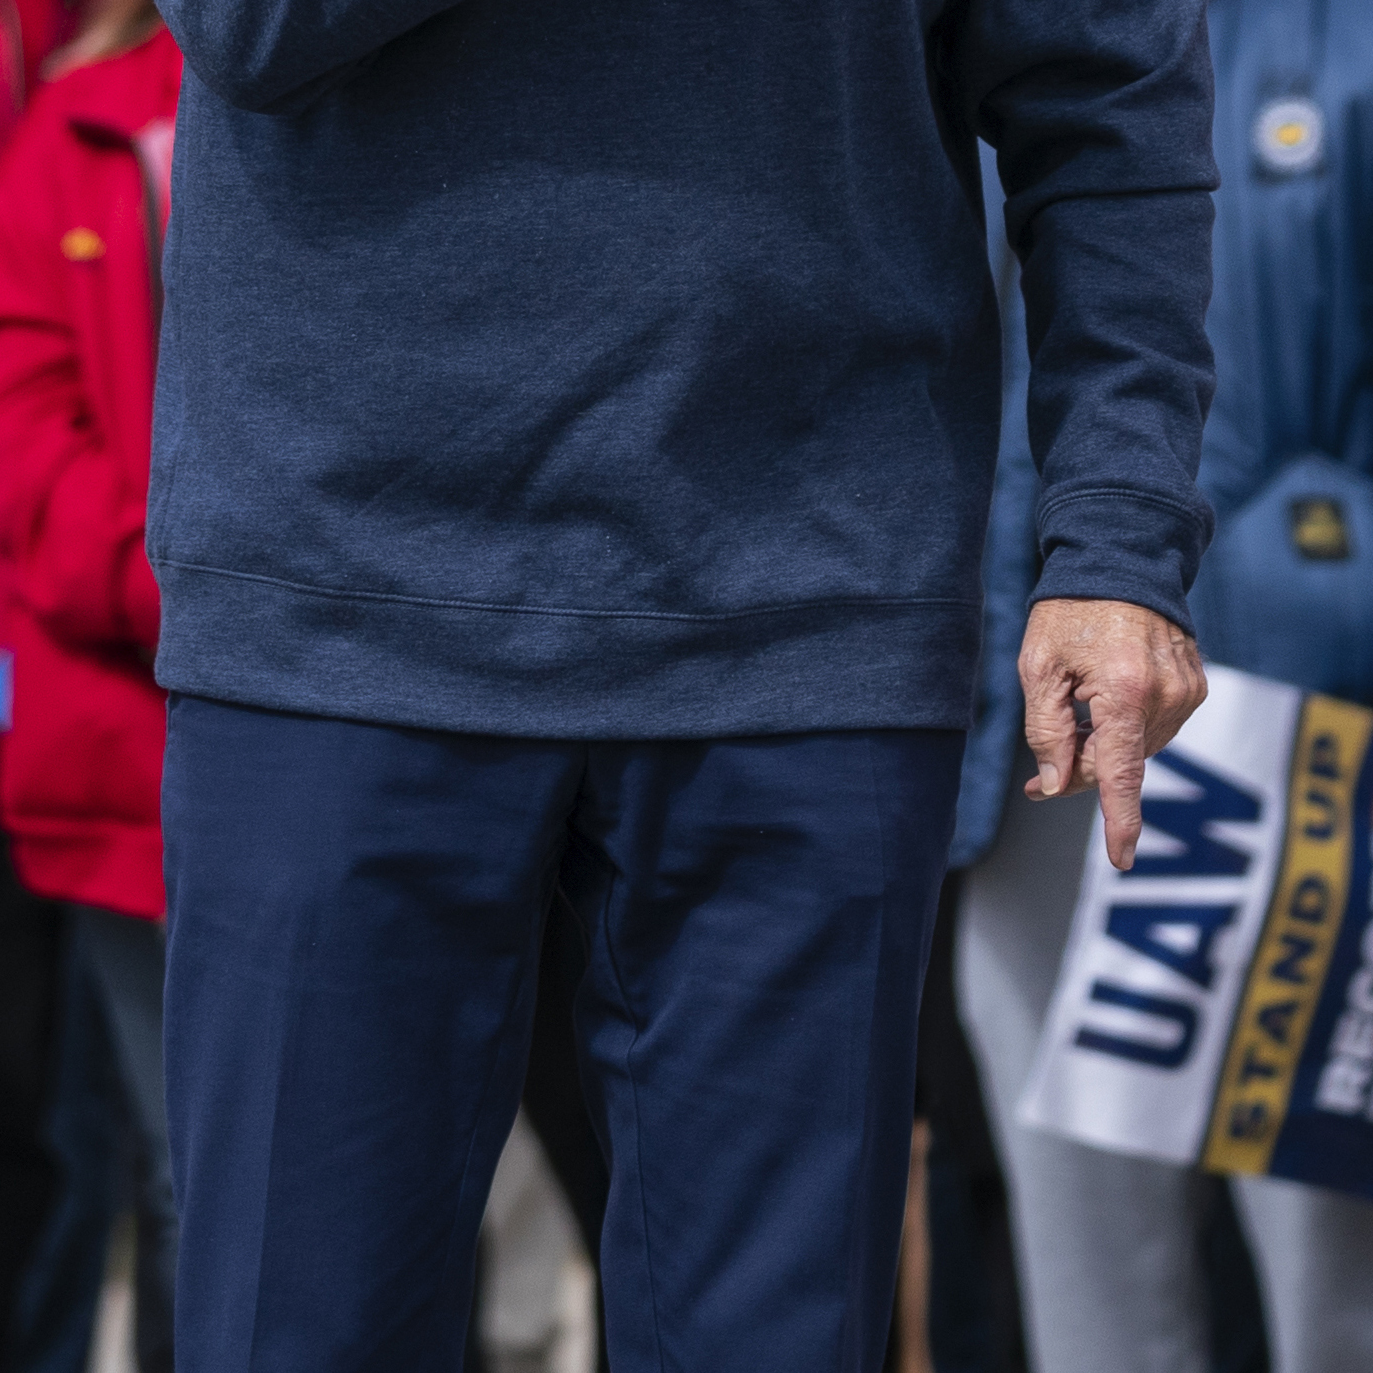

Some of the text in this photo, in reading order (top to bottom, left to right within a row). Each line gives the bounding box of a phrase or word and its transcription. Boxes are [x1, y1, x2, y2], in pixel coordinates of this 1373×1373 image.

[1067, 740, 1270, 1072] UAW
[1227, 729, 1344, 1140] STAND UP
